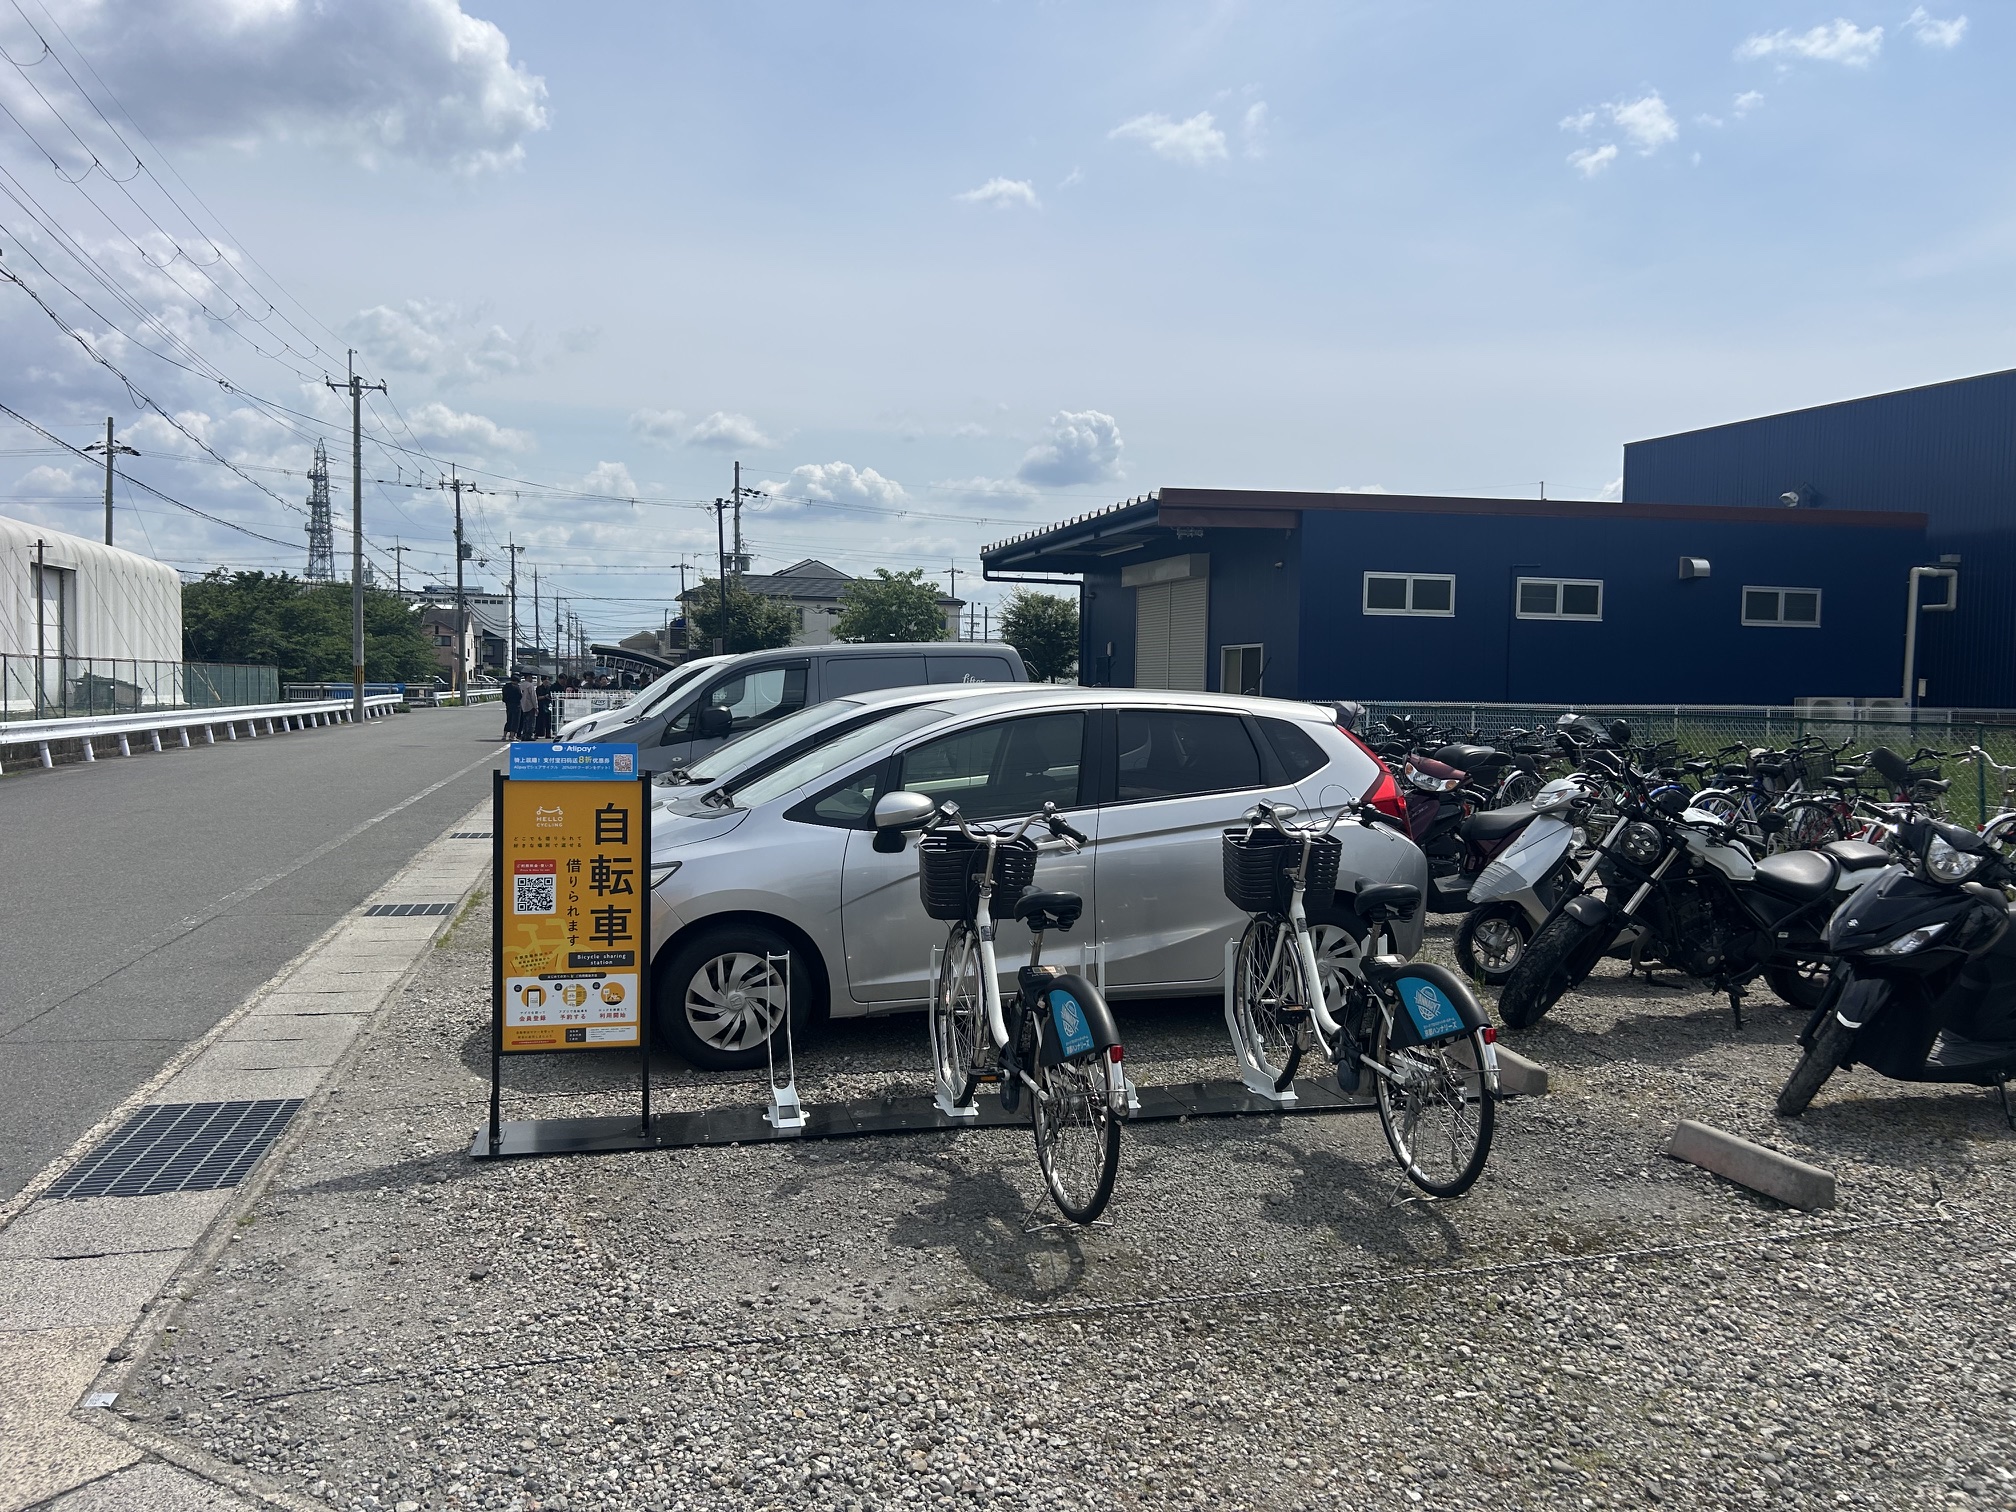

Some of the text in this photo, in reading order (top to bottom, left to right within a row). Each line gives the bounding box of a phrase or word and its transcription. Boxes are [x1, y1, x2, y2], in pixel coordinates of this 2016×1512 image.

[566, 858, 582, 947] 借りられます
[589, 802, 633, 947] 自転車
